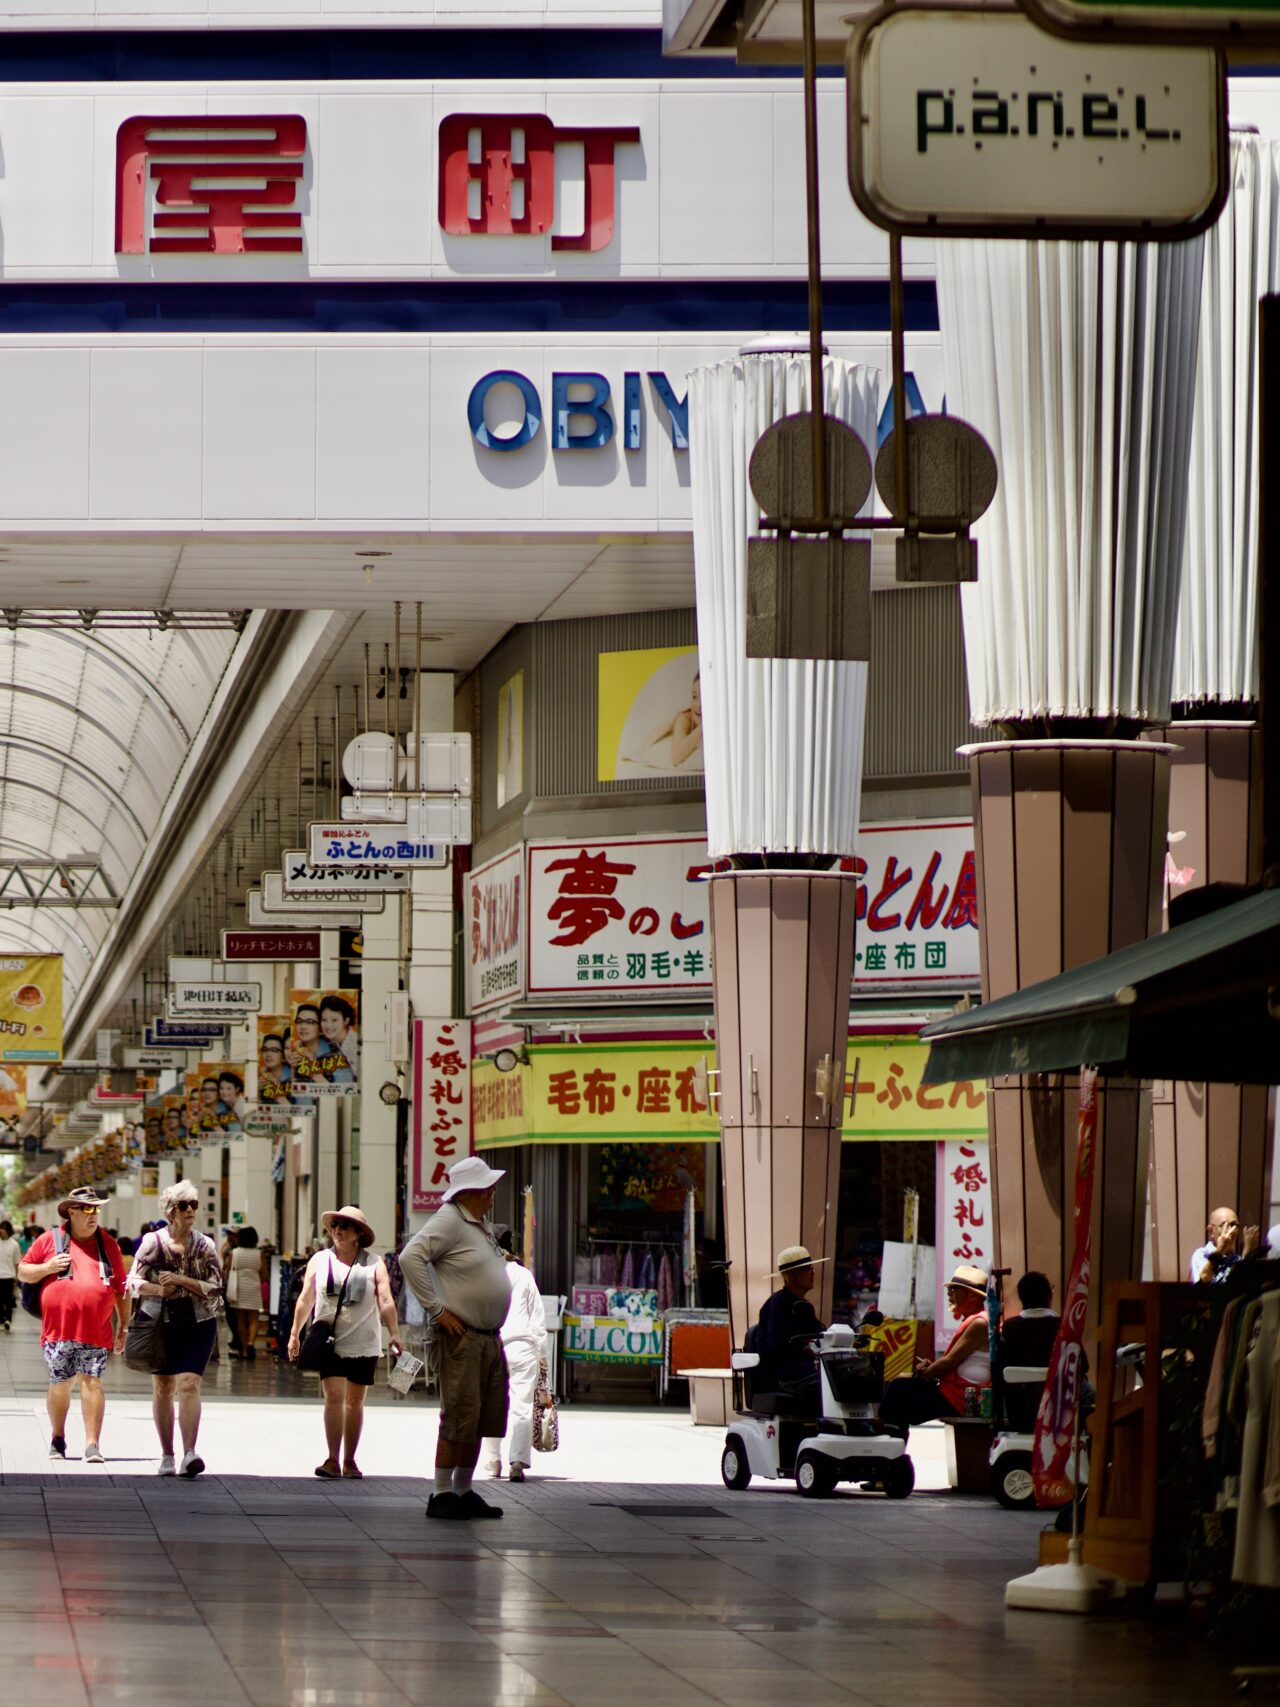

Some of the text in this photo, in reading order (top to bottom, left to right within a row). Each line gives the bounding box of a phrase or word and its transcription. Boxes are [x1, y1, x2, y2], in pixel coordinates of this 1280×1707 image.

[326, 840, 435, 859] ふとんの西川
[229, 940, 315, 951] リッチモンドホテル
[576, 953, 618, 966] 品質と
[576, 968, 619, 981] 信頼の
